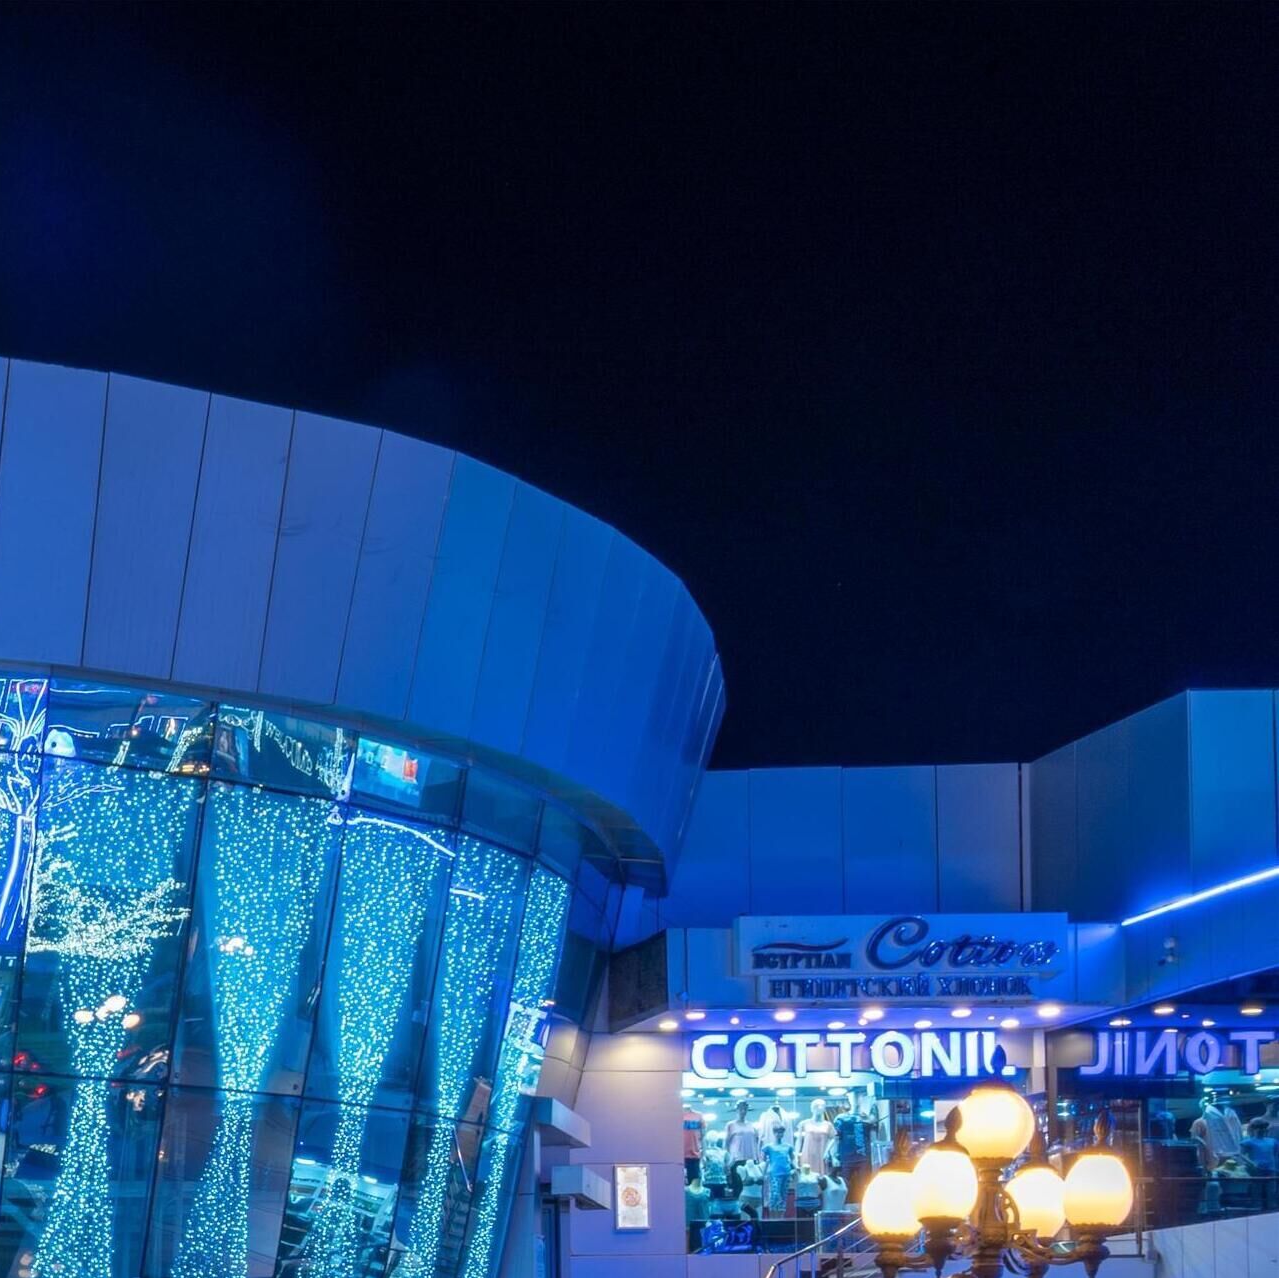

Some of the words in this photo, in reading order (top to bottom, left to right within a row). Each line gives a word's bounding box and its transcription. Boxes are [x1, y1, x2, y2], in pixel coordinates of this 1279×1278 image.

[752, 952, 851, 970] EGYPTIAN
[865, 915, 1060, 971] Cotton
[768, 972, 931, 999] ЕГИПЕТСКИЙ
[936, 974, 1033, 998] ХЛОПОК
[691, 1031, 1016, 1079] COTTONIL
